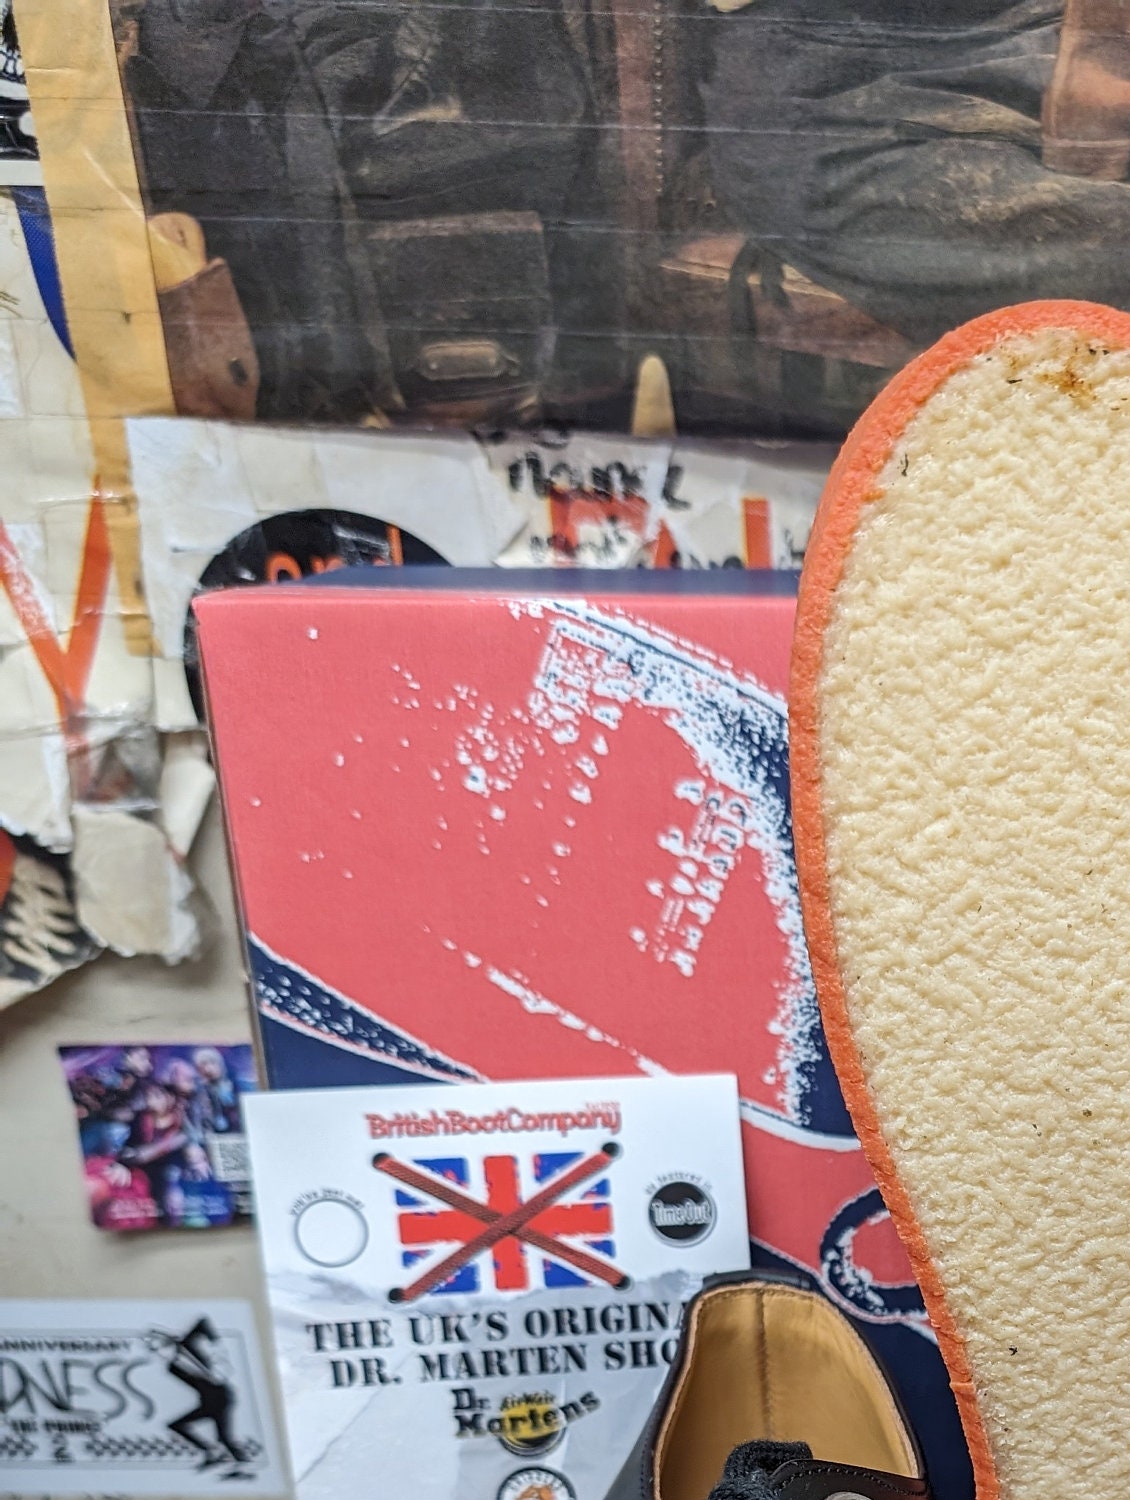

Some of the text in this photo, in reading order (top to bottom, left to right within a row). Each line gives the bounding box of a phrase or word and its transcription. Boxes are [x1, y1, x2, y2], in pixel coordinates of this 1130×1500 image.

[305, 1317, 395, 1353] THE
[407, 1311, 509, 1346] UK'S
[328, 1356, 403, 1389] DR.
[418, 1342, 589, 1383] MARTEN
[454, 1391, 601, 1438] Martens
